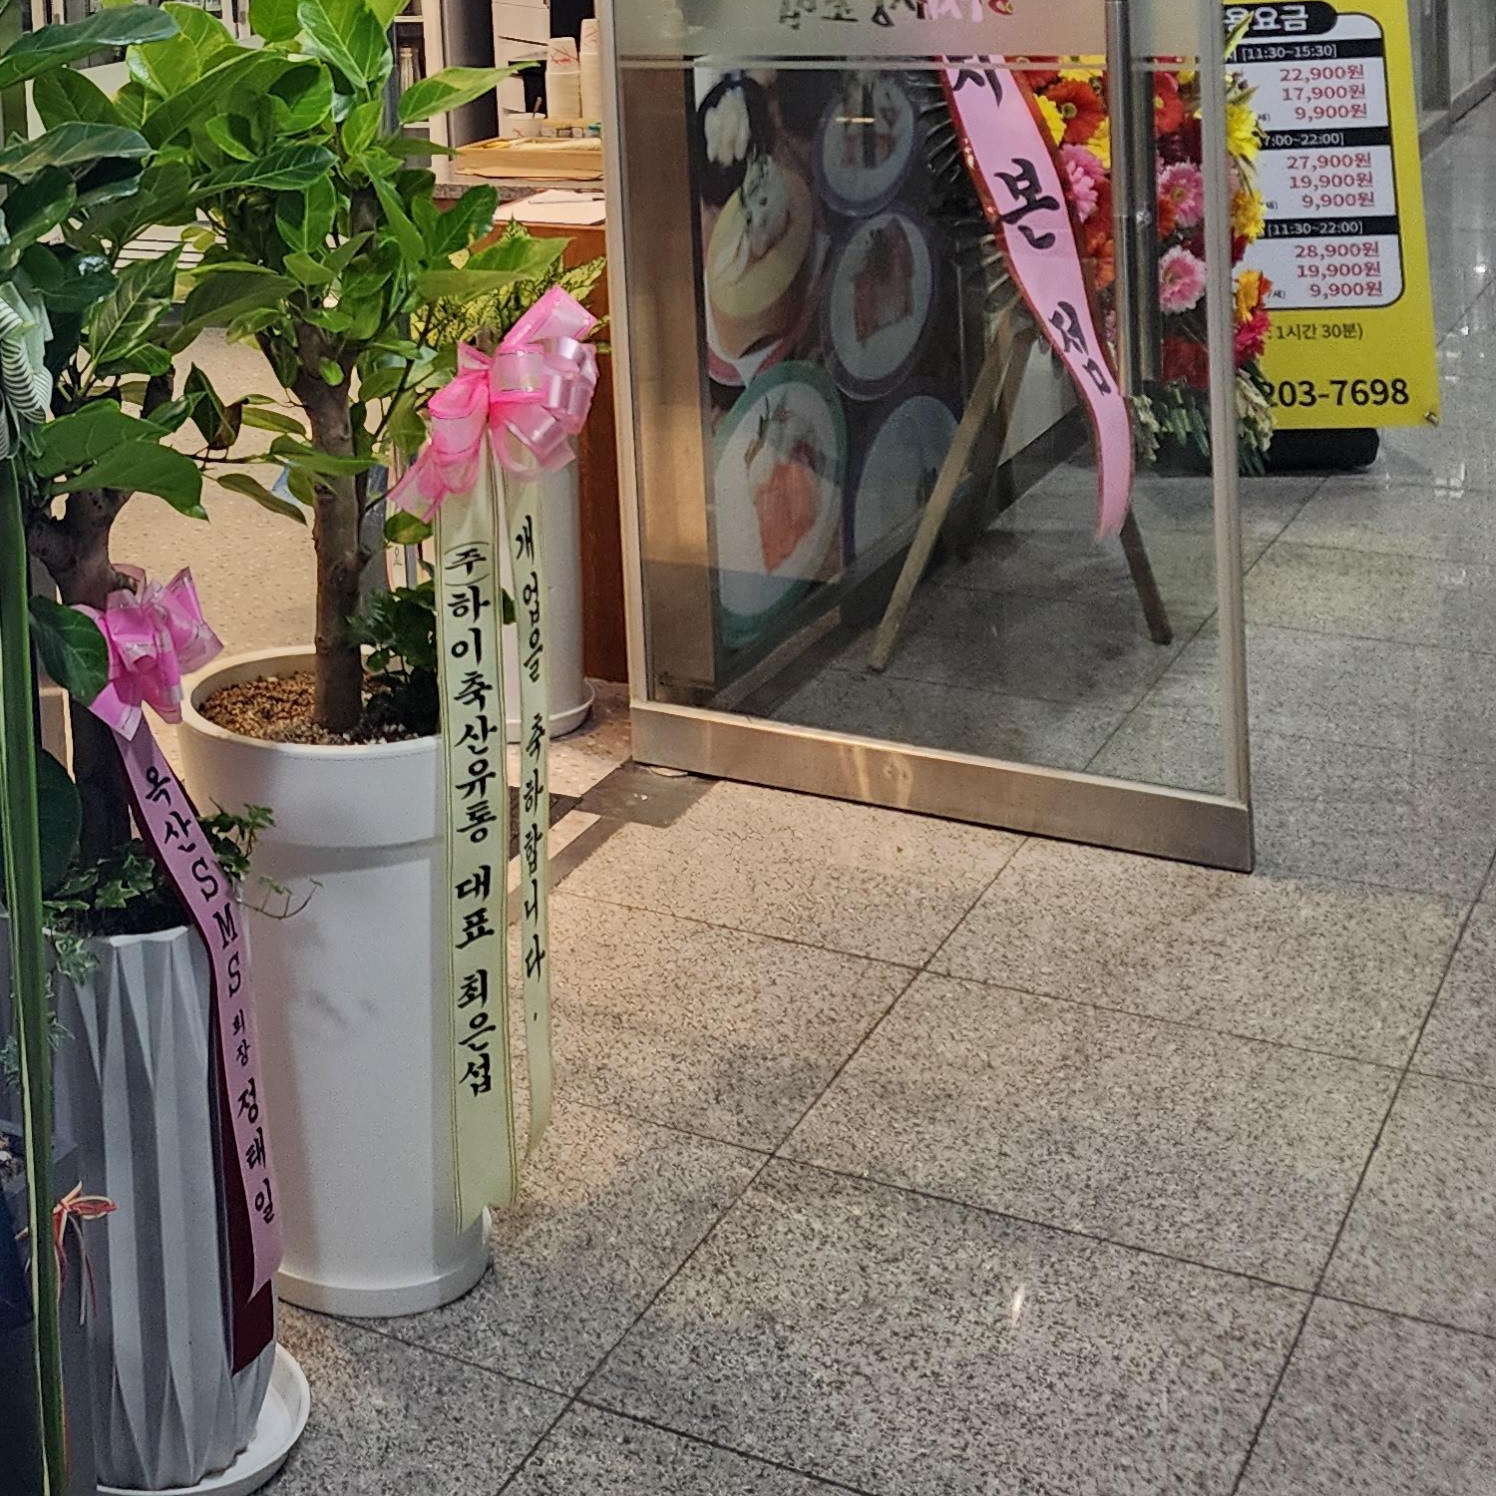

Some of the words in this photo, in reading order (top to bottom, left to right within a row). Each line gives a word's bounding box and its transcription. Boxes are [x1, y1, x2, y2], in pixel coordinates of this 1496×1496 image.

[1224, 5, 1308, 33] 용요금
[1279, 64, 1365, 83] 22,900원
[1282, 84, 1365, 102] 17,900원
[1294, 103, 1367, 122] 9,900원
[1264, 133, 1344, 147] 7:00~22:00]
[1287, 152, 1372, 172] 27,900원
[1289, 171, 1373, 191] 19,900원
[1302, 191, 1375, 210] 9,900원
[1294, 242, 1380, 261] 28,900원
[1297, 261, 1381, 280] 19,900원
[1310, 281, 1383, 299] 9,900원
[1270, 377, 1410, 407] 203-7698
[455, 864, 496, 950] 대표
